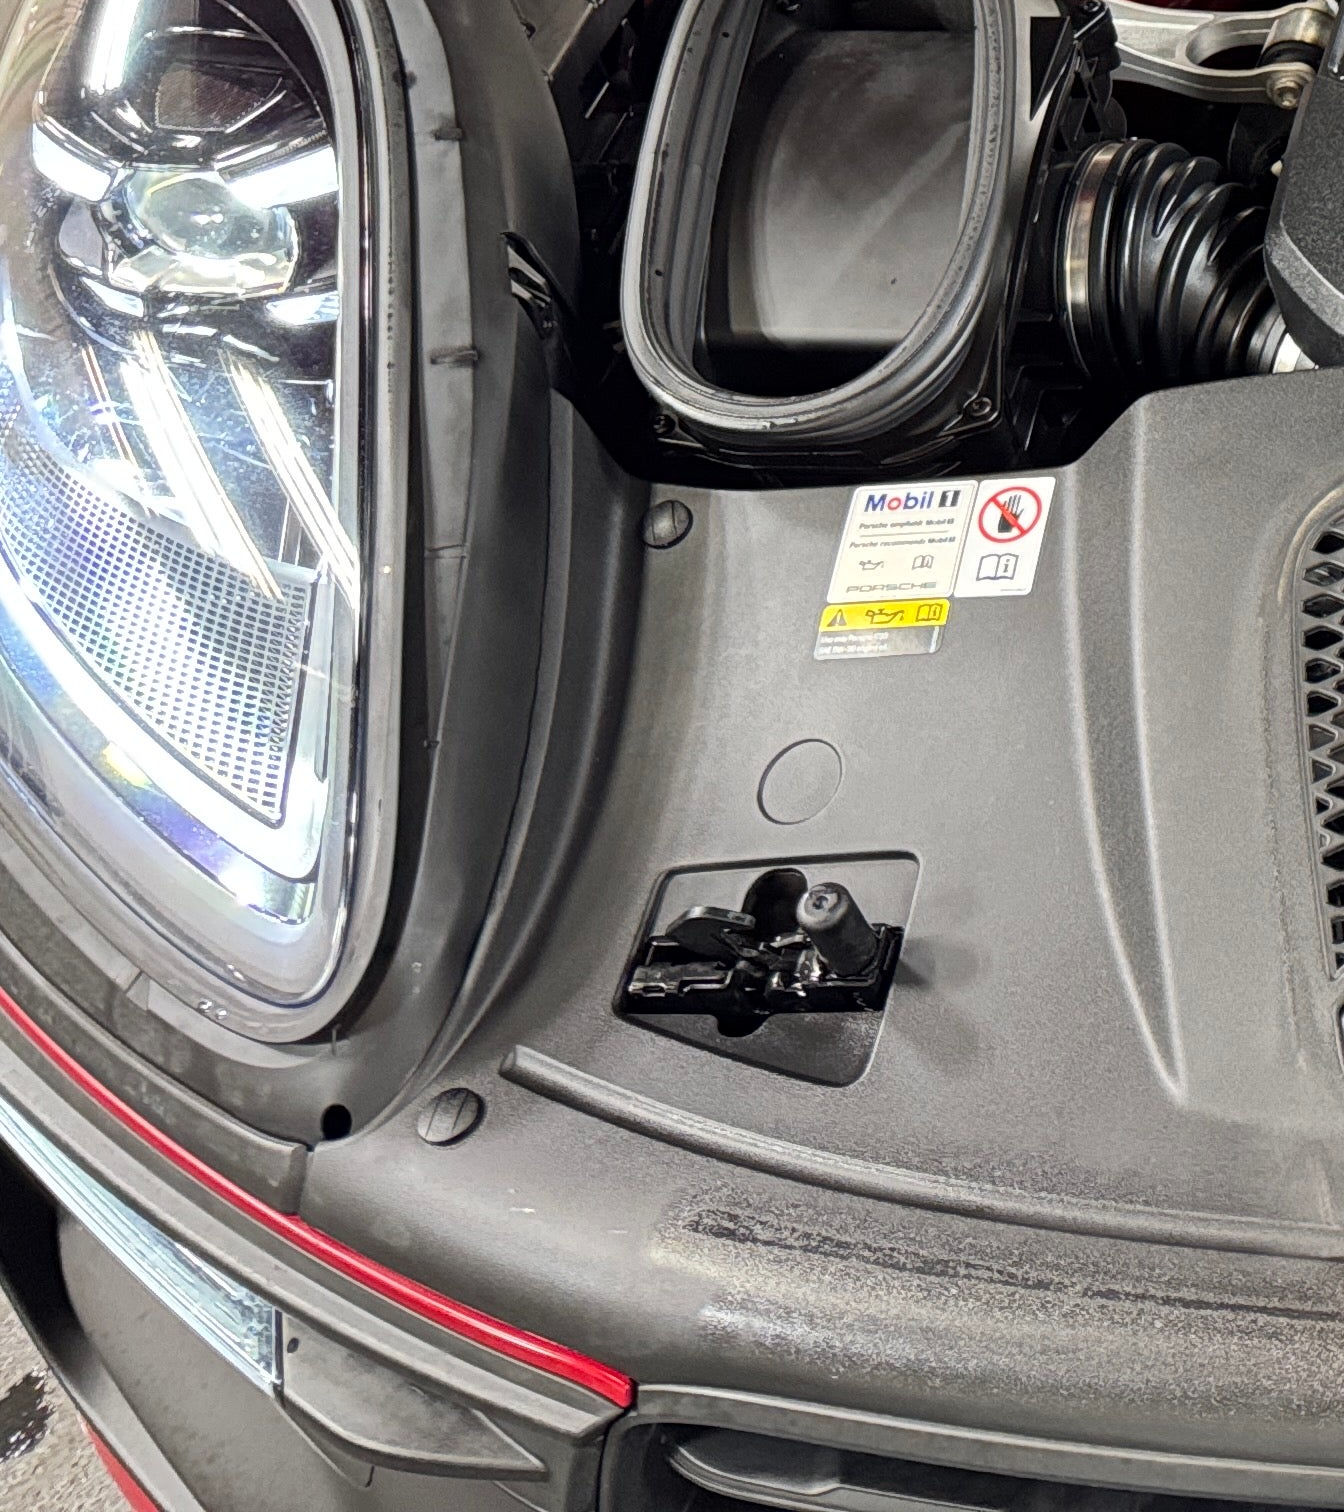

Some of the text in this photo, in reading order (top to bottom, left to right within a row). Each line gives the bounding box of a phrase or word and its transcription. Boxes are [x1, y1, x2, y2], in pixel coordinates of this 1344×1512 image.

[864, 490, 961, 513] Mobil 1
[859, 521, 888, 529] Porsche
[849, 541, 879, 549] Porsche
[846, 581, 937, 593] PORSCHE
